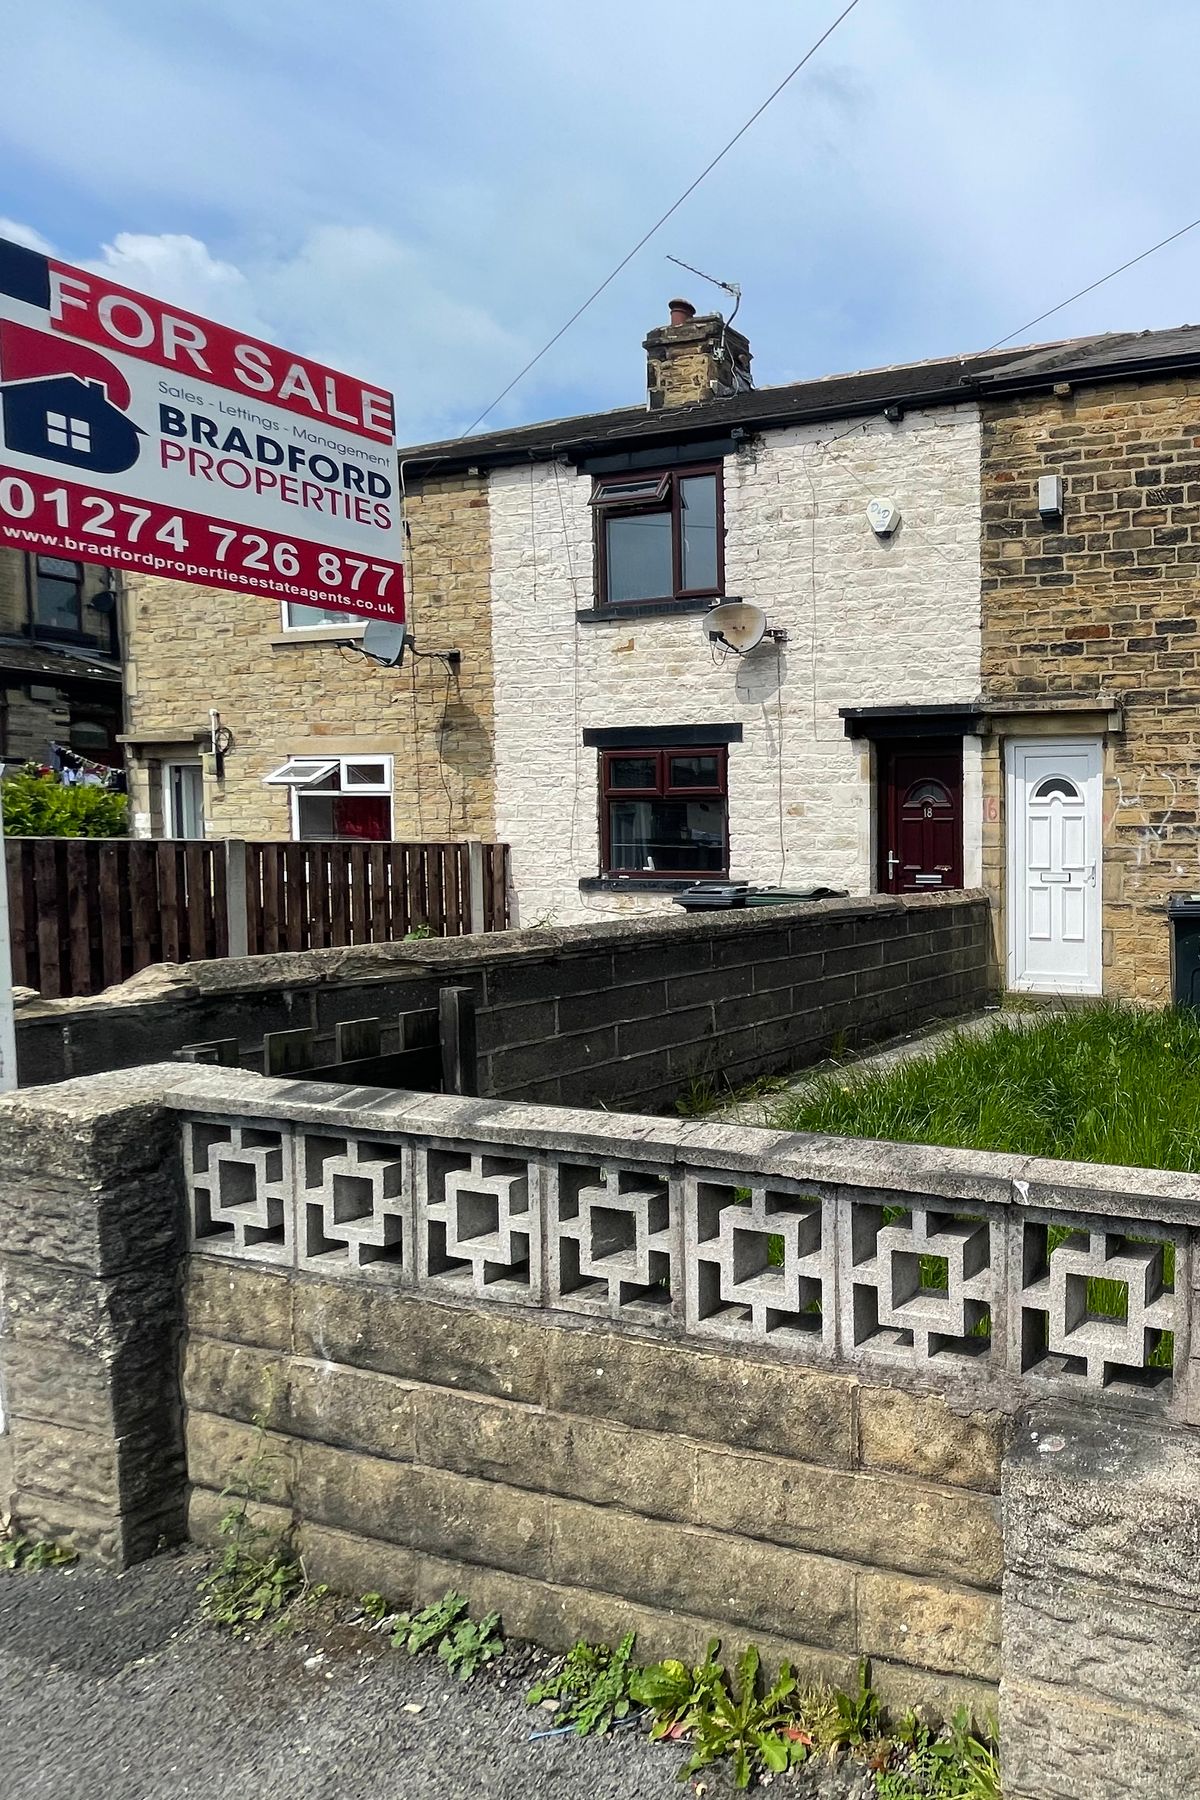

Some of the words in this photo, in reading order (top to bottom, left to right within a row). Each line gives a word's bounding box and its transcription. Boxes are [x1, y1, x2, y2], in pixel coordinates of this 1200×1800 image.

[50, 270, 213, 374] FOR
[234, 344, 393, 437] SALE
[158, 381, 204, 406] Sales
[219, 400, 279, 432] Lettings
[293, 426, 391, 468] Management
[159, 403, 392, 499] BRADFORD
[160, 439, 392, 530] PROPERTIES
[0, 477, 189, 553] 01274
[208, 525, 300, 577] 726
[318, 552, 395, 597] 877
[3, 525, 395, 615] www.bradfordpropertiesestateagents.co.uk
[923, 807, 933, 818] 18
